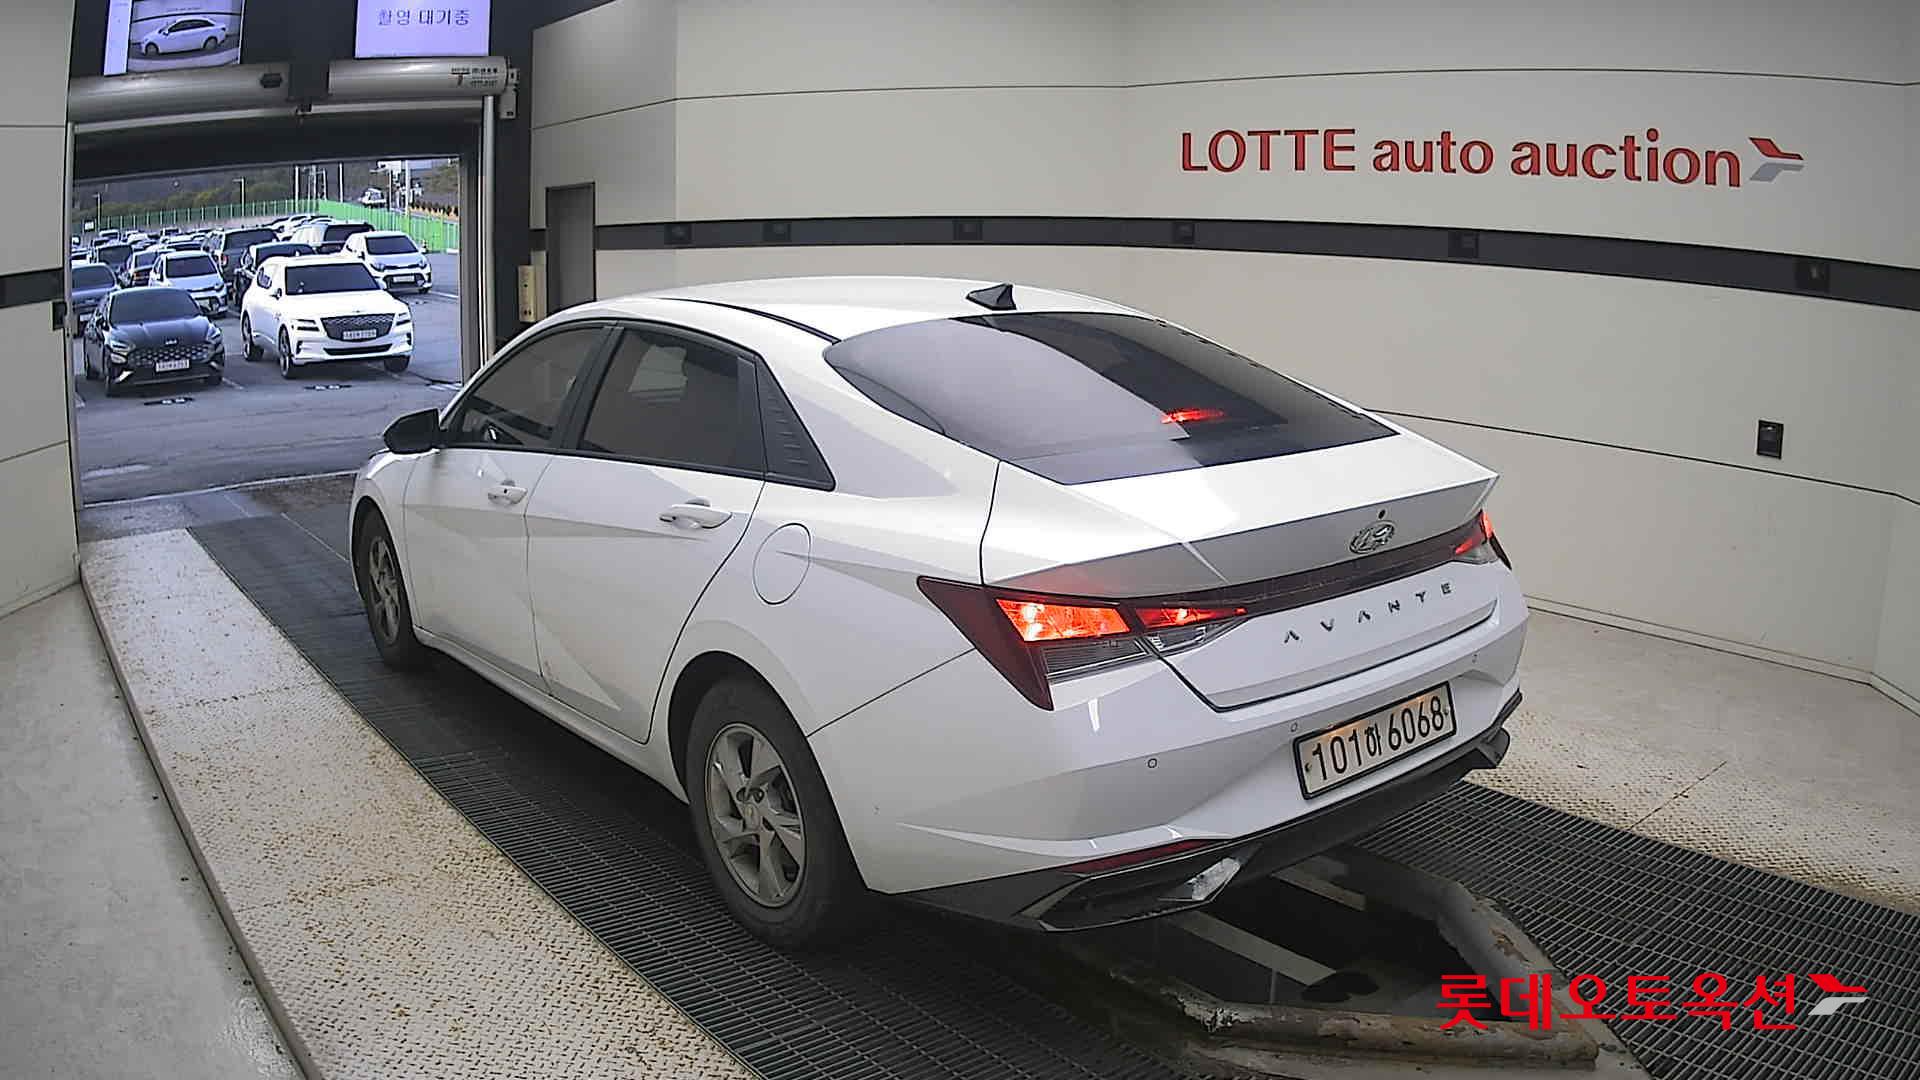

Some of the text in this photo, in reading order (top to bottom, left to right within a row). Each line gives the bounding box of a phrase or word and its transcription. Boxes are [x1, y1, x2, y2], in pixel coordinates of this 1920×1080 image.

[418, 8, 470, 26] 대기중
[1181, 127, 1741, 188] LOTTE auto auction
[1284, 582, 1452, 643] AVANTE
